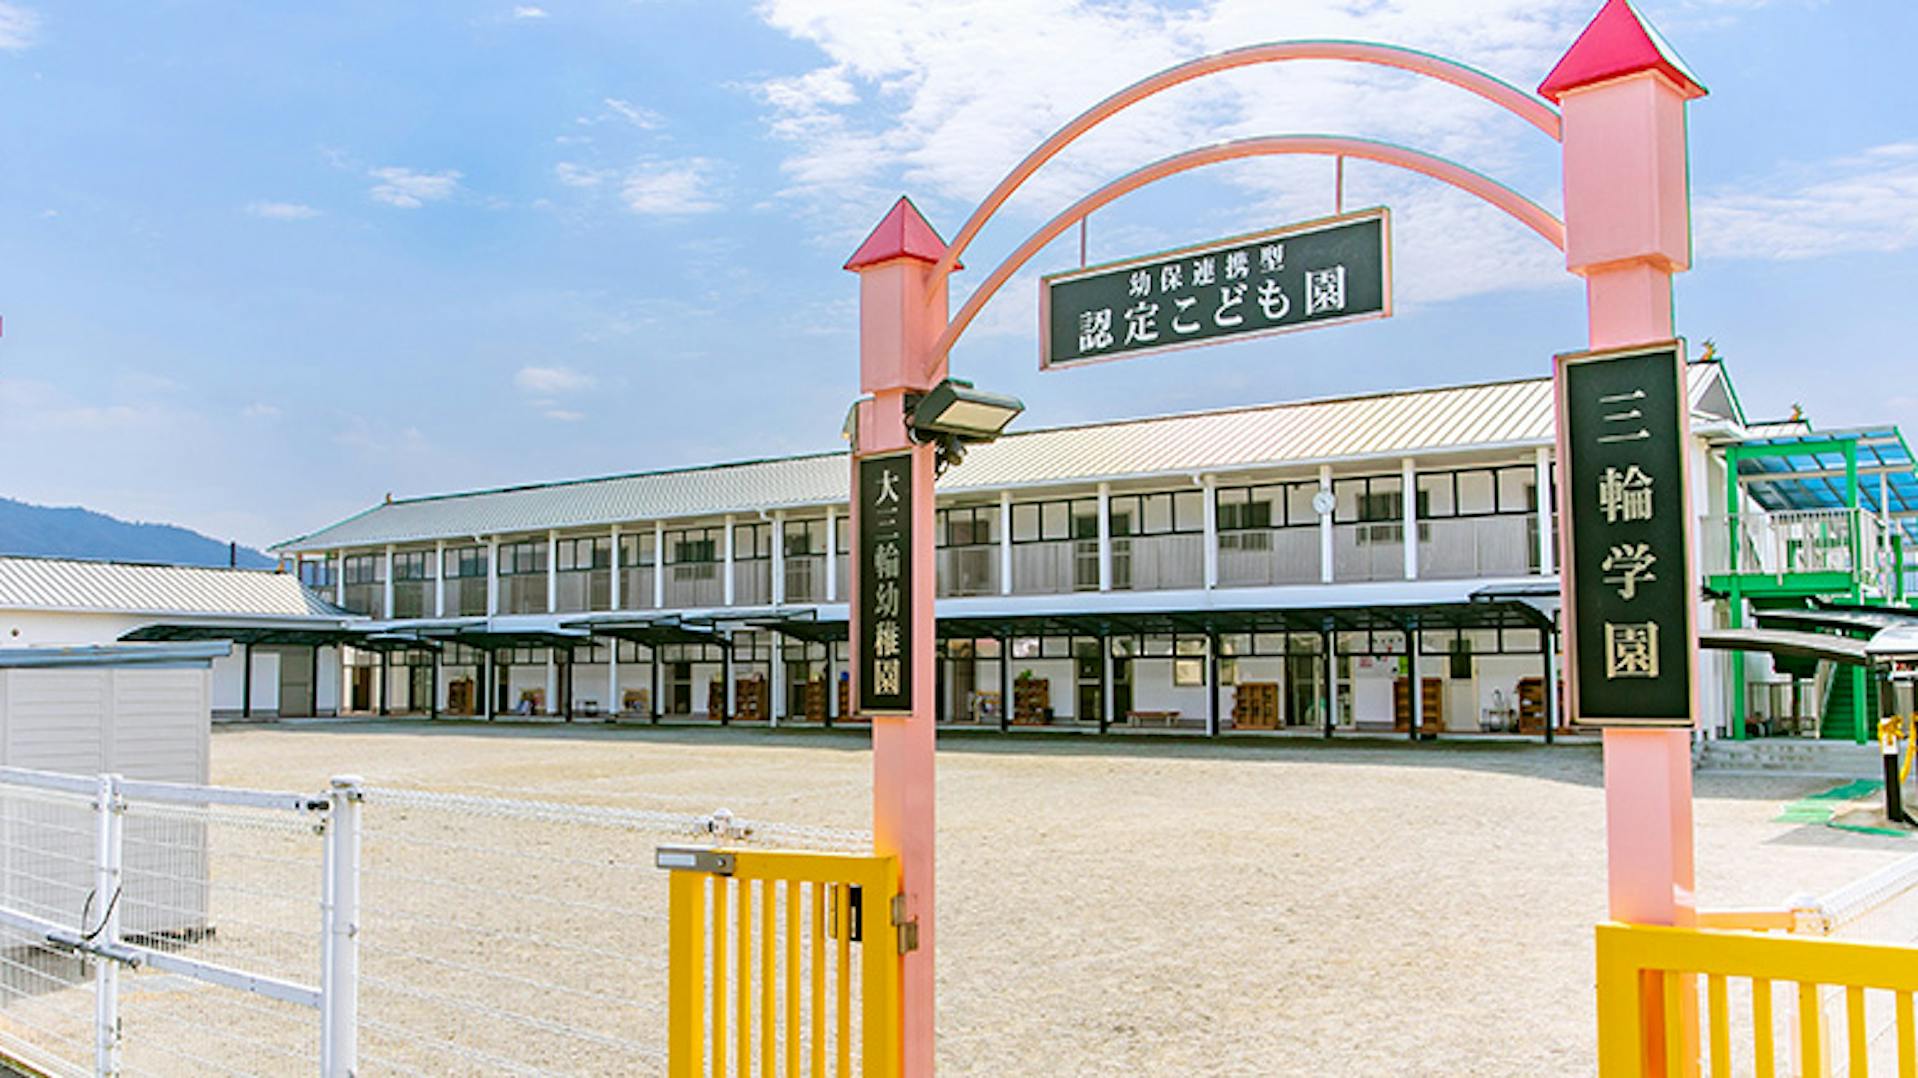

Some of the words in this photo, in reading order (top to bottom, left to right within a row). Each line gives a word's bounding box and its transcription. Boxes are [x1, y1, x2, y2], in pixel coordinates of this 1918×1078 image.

[1078, 264, 1346, 352] 認定こども園
[1129, 244, 1286, 297] 幼保連携型
[873, 469, 901, 696] 大三輪幼稚園
[1597, 388, 1660, 680] 三輪学園
